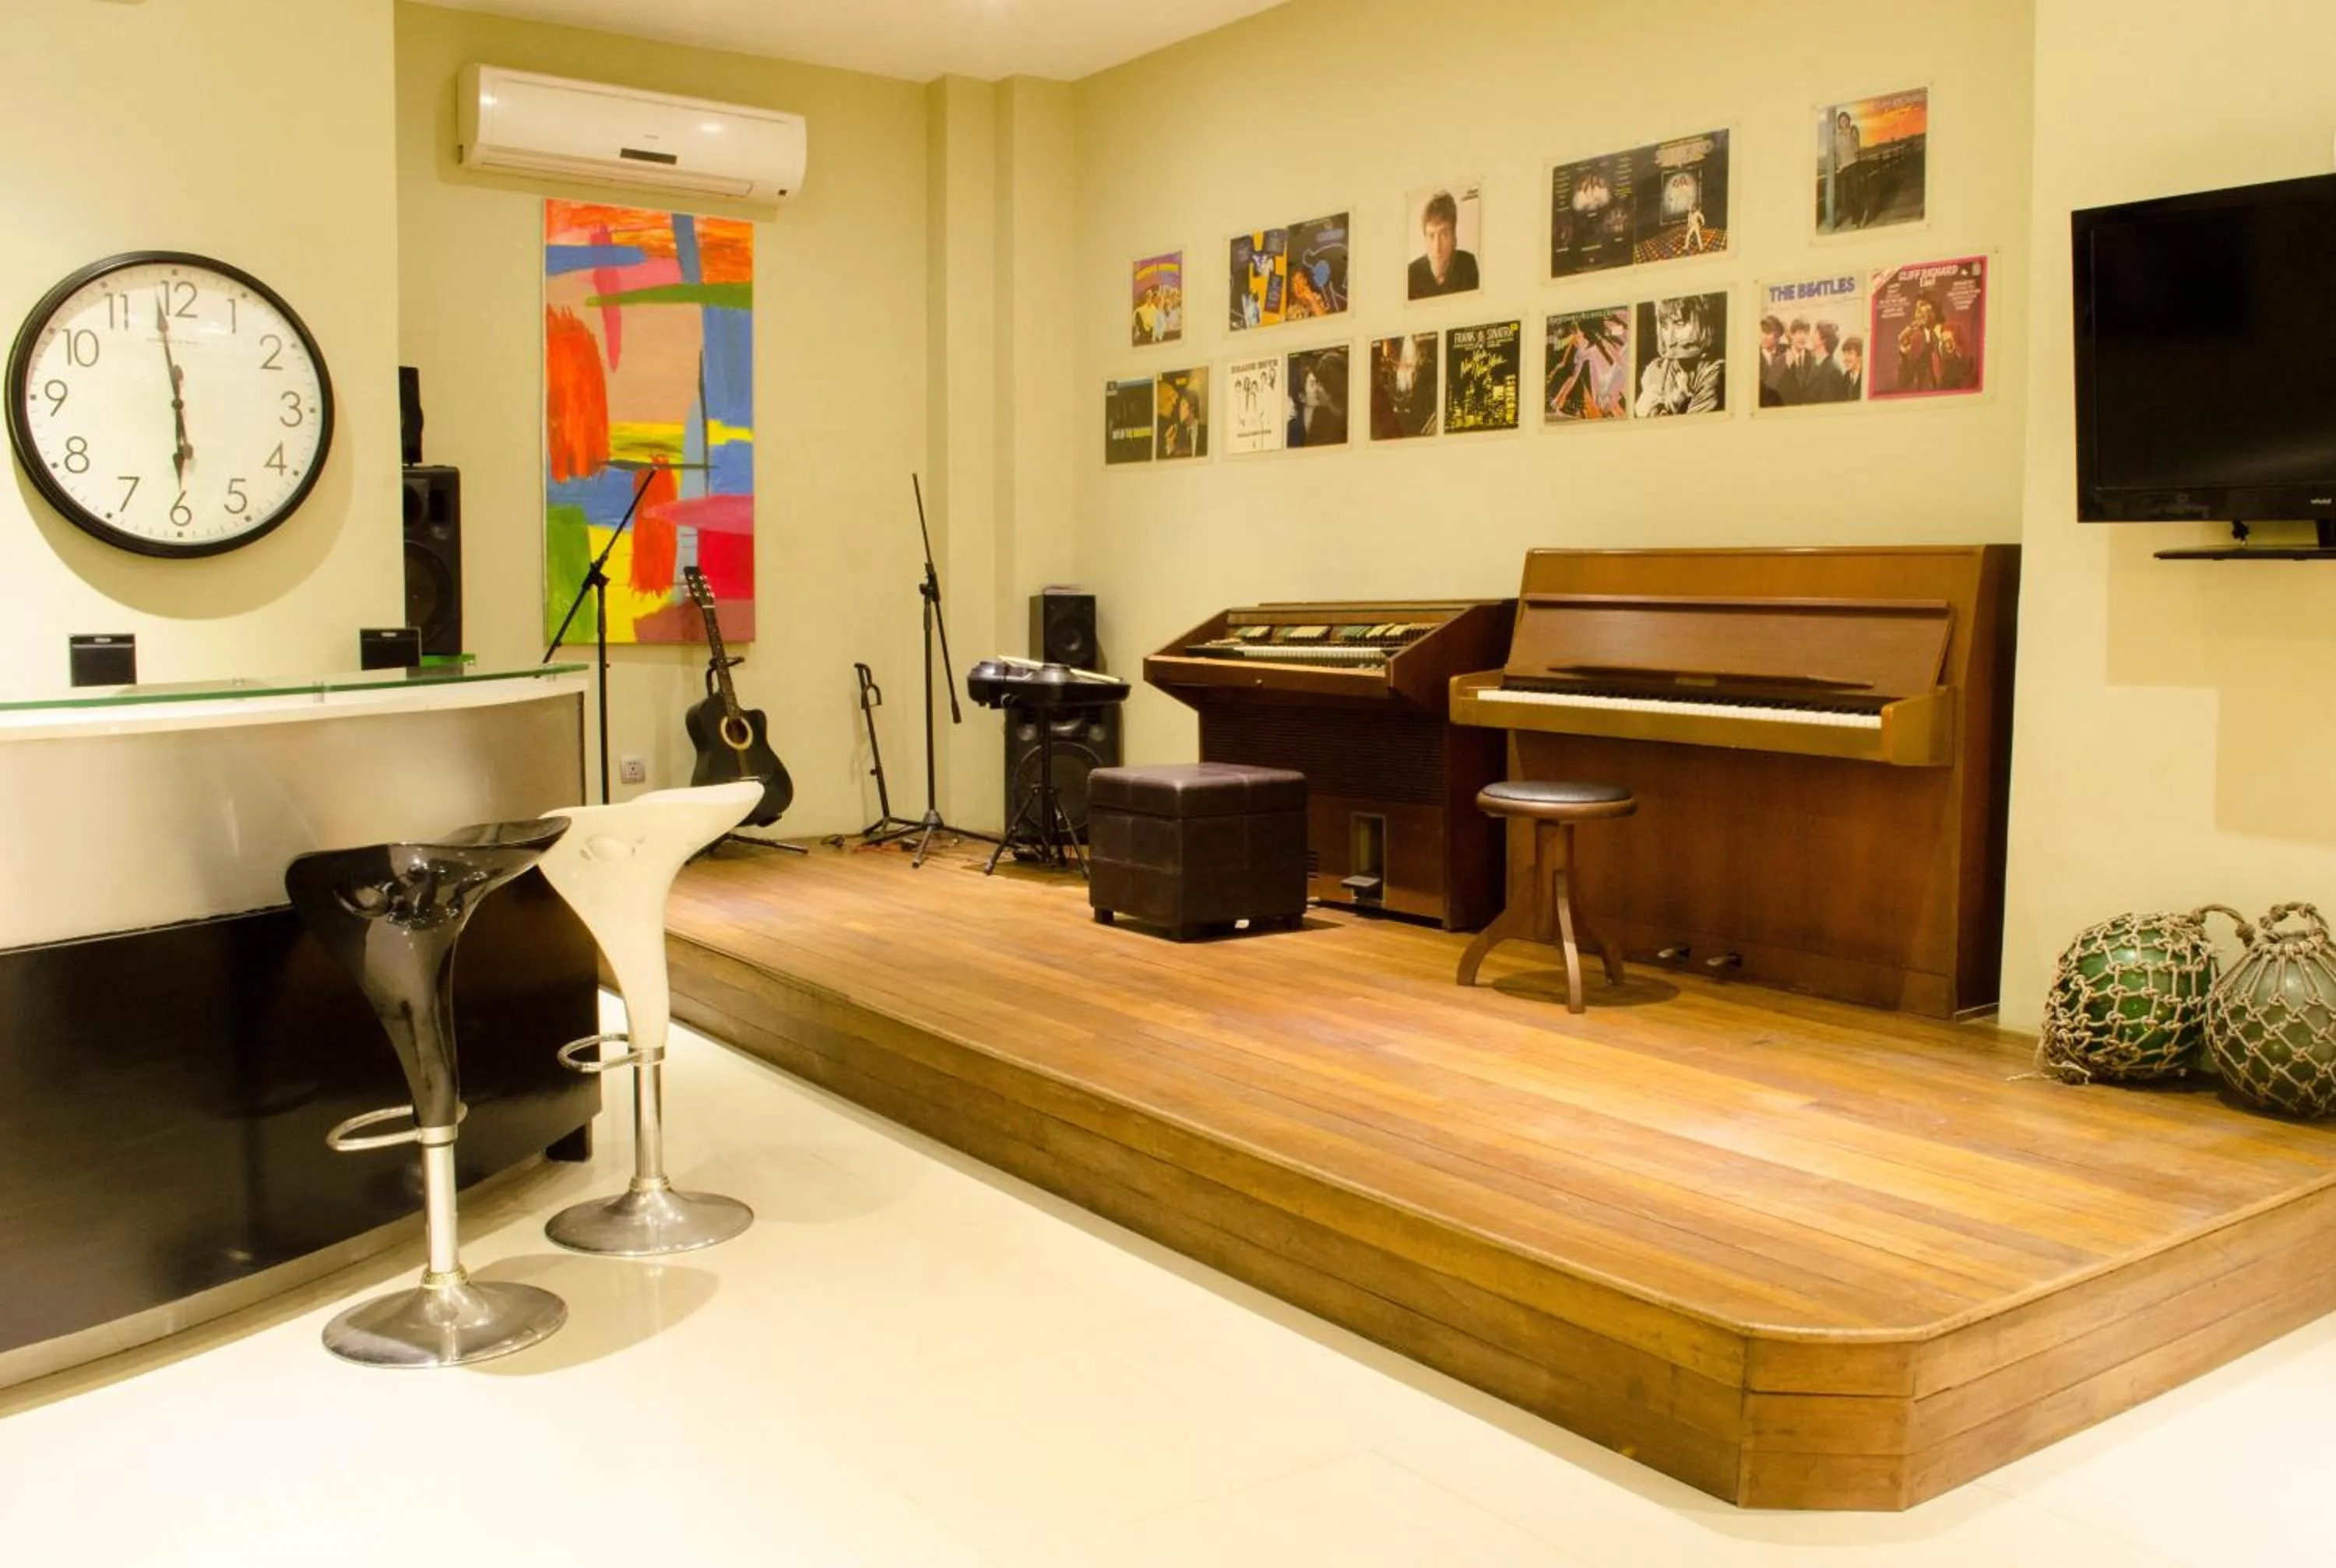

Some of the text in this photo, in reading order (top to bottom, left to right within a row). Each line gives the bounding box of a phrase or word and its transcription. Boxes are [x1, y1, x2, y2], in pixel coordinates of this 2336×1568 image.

[161, 280, 199, 318] 12
[1768, 284, 1796, 303] THE
[1797, 276, 1856, 300] BEATLES
[104, 293, 128, 330] 11
[227, 298, 237, 334] 1
[63, 329, 100, 367] 10
[259, 334, 283, 370] 2
[44, 379, 68, 417] 9
[280, 391, 303, 427] 3
[65, 436, 90, 473] 8
[264, 442, 287, 476] 4
[118, 476, 141, 512] 7
[170, 490, 192, 527] 6
[224, 478, 248, 514] 5
